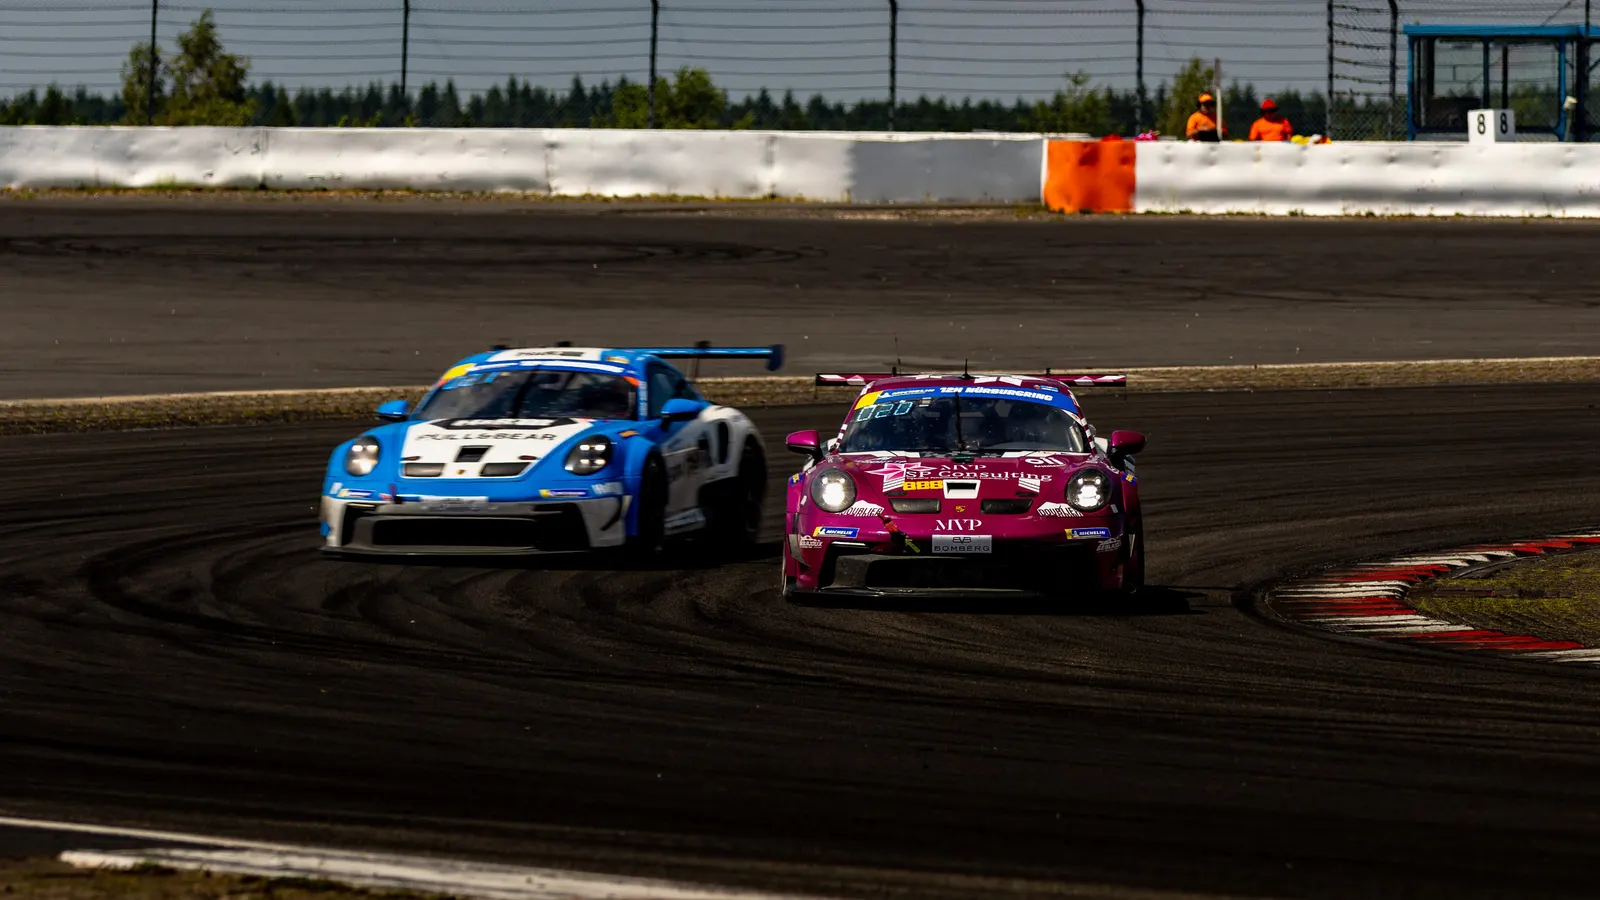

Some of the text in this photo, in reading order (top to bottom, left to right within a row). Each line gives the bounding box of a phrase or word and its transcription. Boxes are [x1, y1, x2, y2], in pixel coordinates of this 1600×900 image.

[1477, 113, 1486, 135] 8
[1500, 111, 1508, 135] 8
[965, 386, 1054, 402] NÜRBURGRING
[938, 470, 1053, 482] Consulting
[934, 519, 982, 531] MVP
